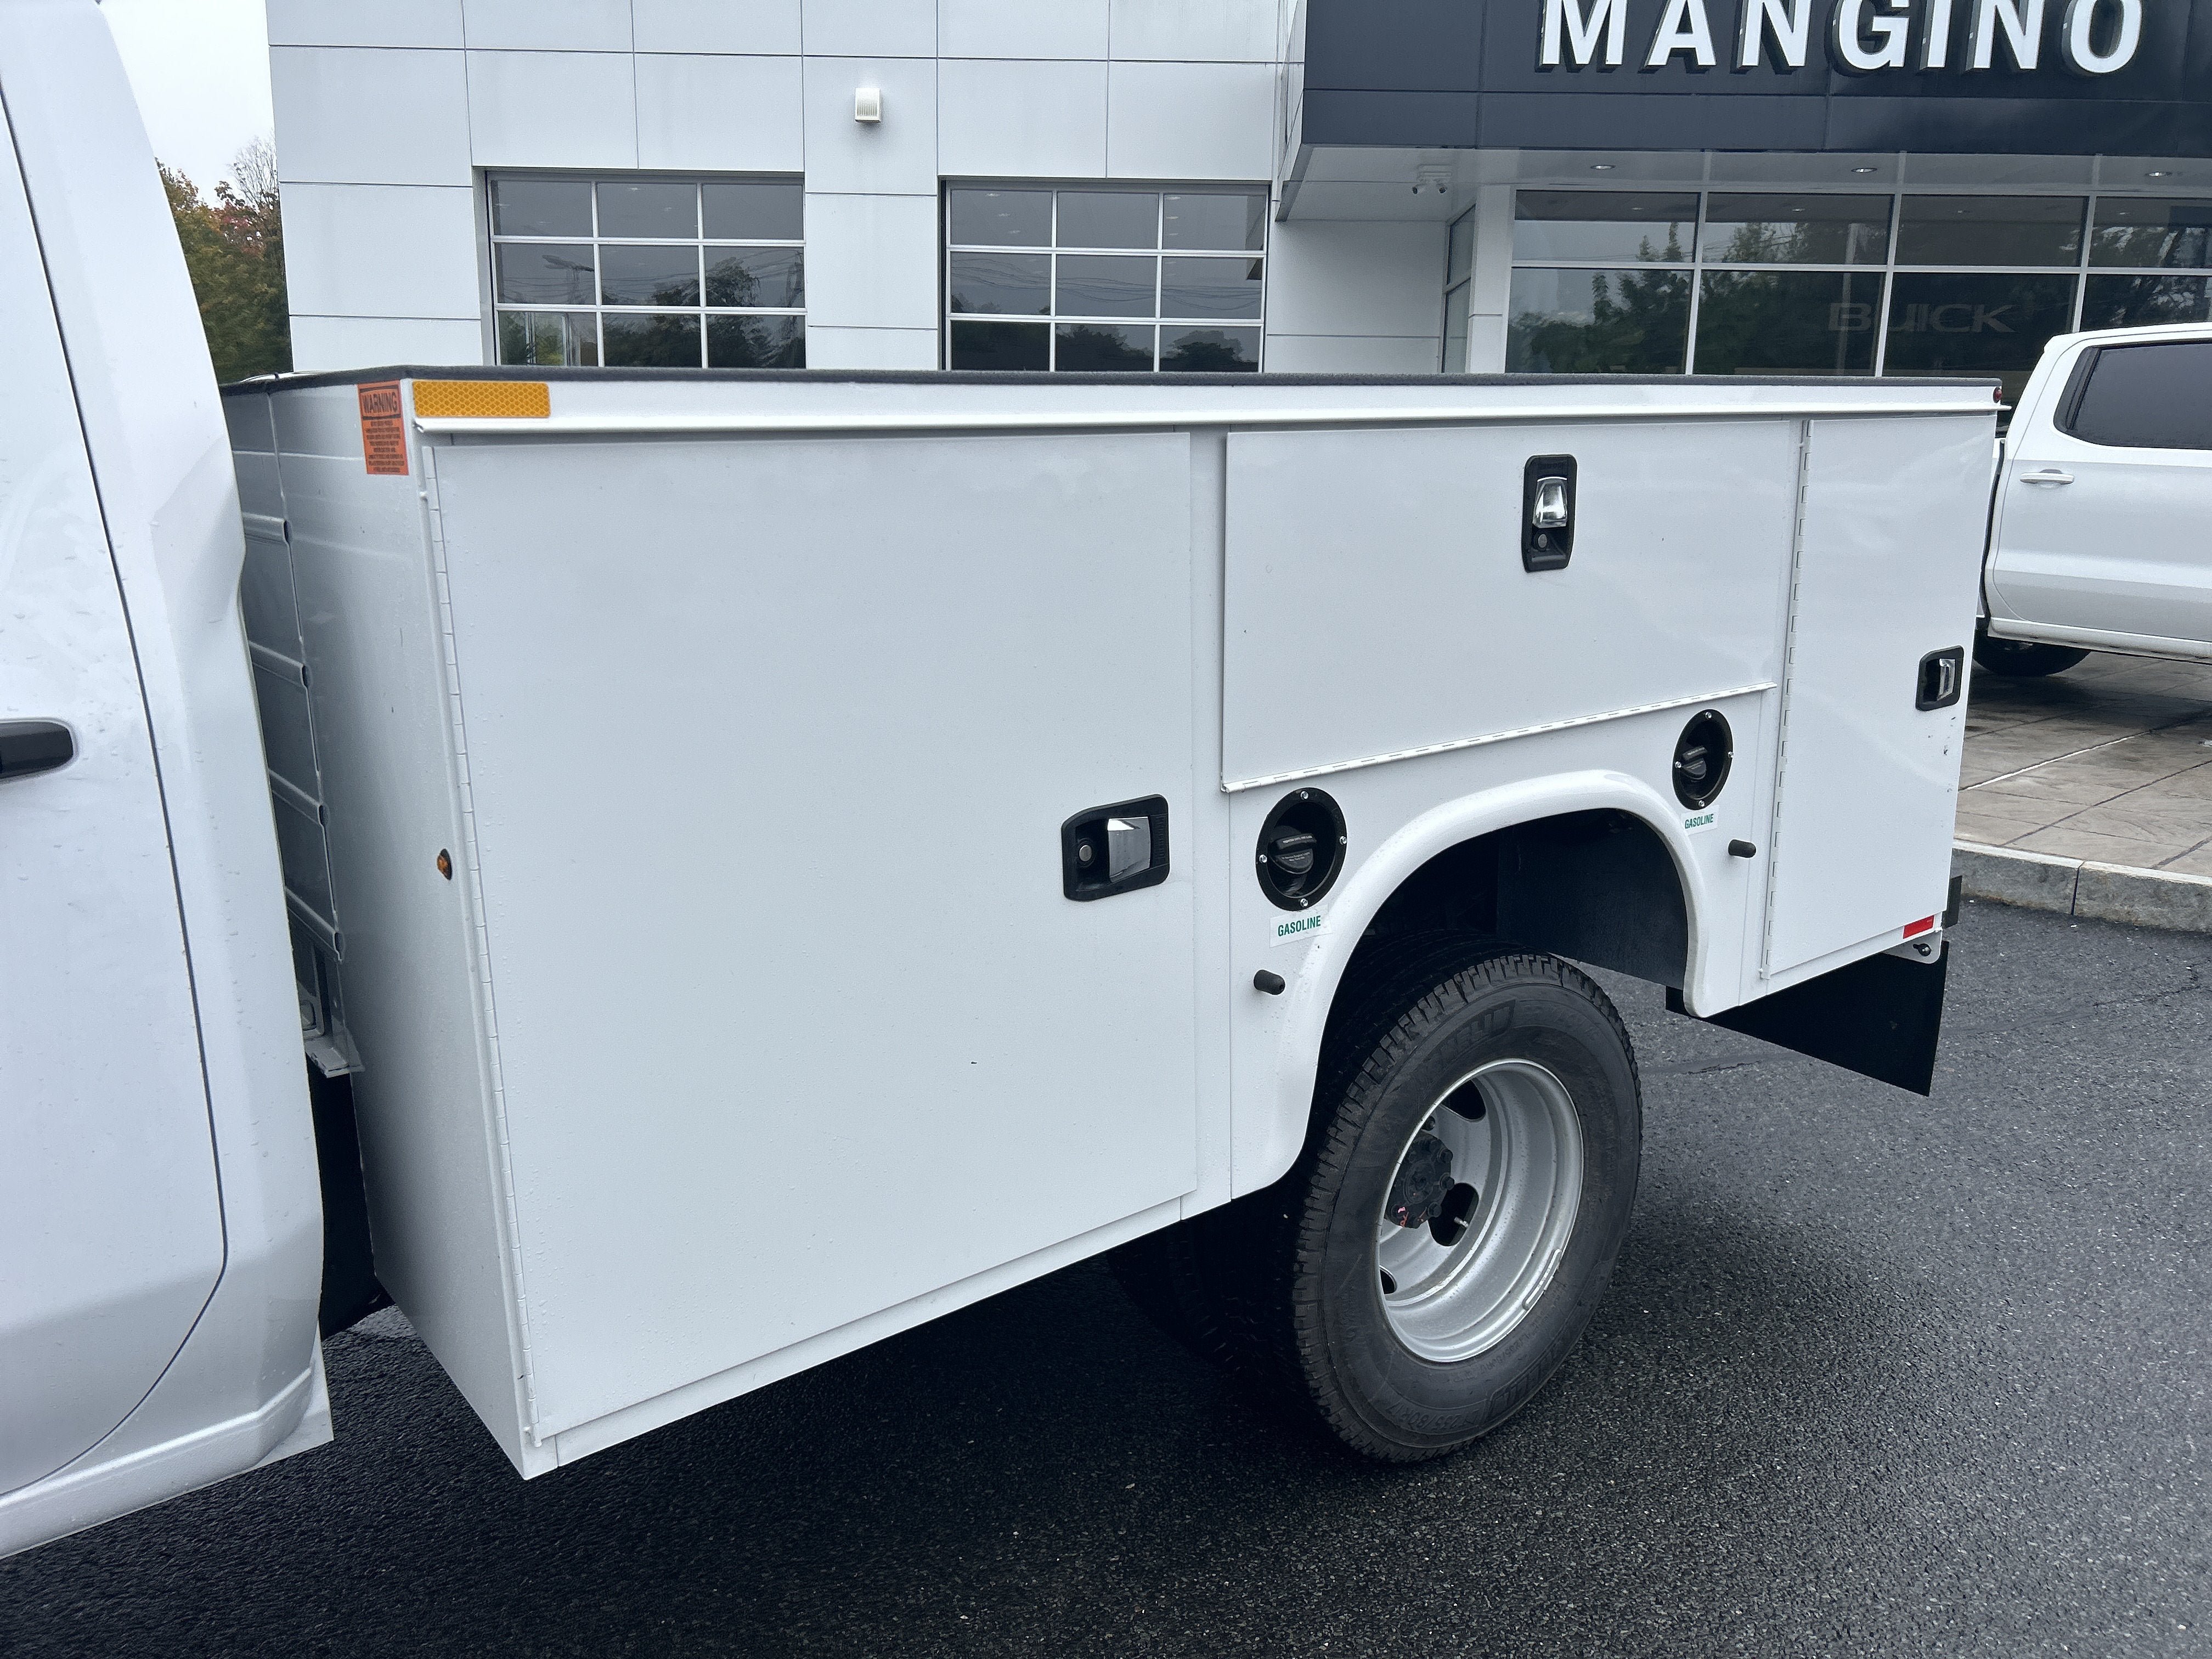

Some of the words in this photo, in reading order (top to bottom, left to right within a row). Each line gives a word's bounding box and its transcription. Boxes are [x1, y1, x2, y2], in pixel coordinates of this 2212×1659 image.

[1539, 0, 2142, 74] MANGINO
[1829, 302, 2019, 332] BUICK
[363, 392, 398, 413] WARNING
[1685, 814, 1714, 829] GASOLINE
[1278, 915, 1321, 936] GASOLINE
